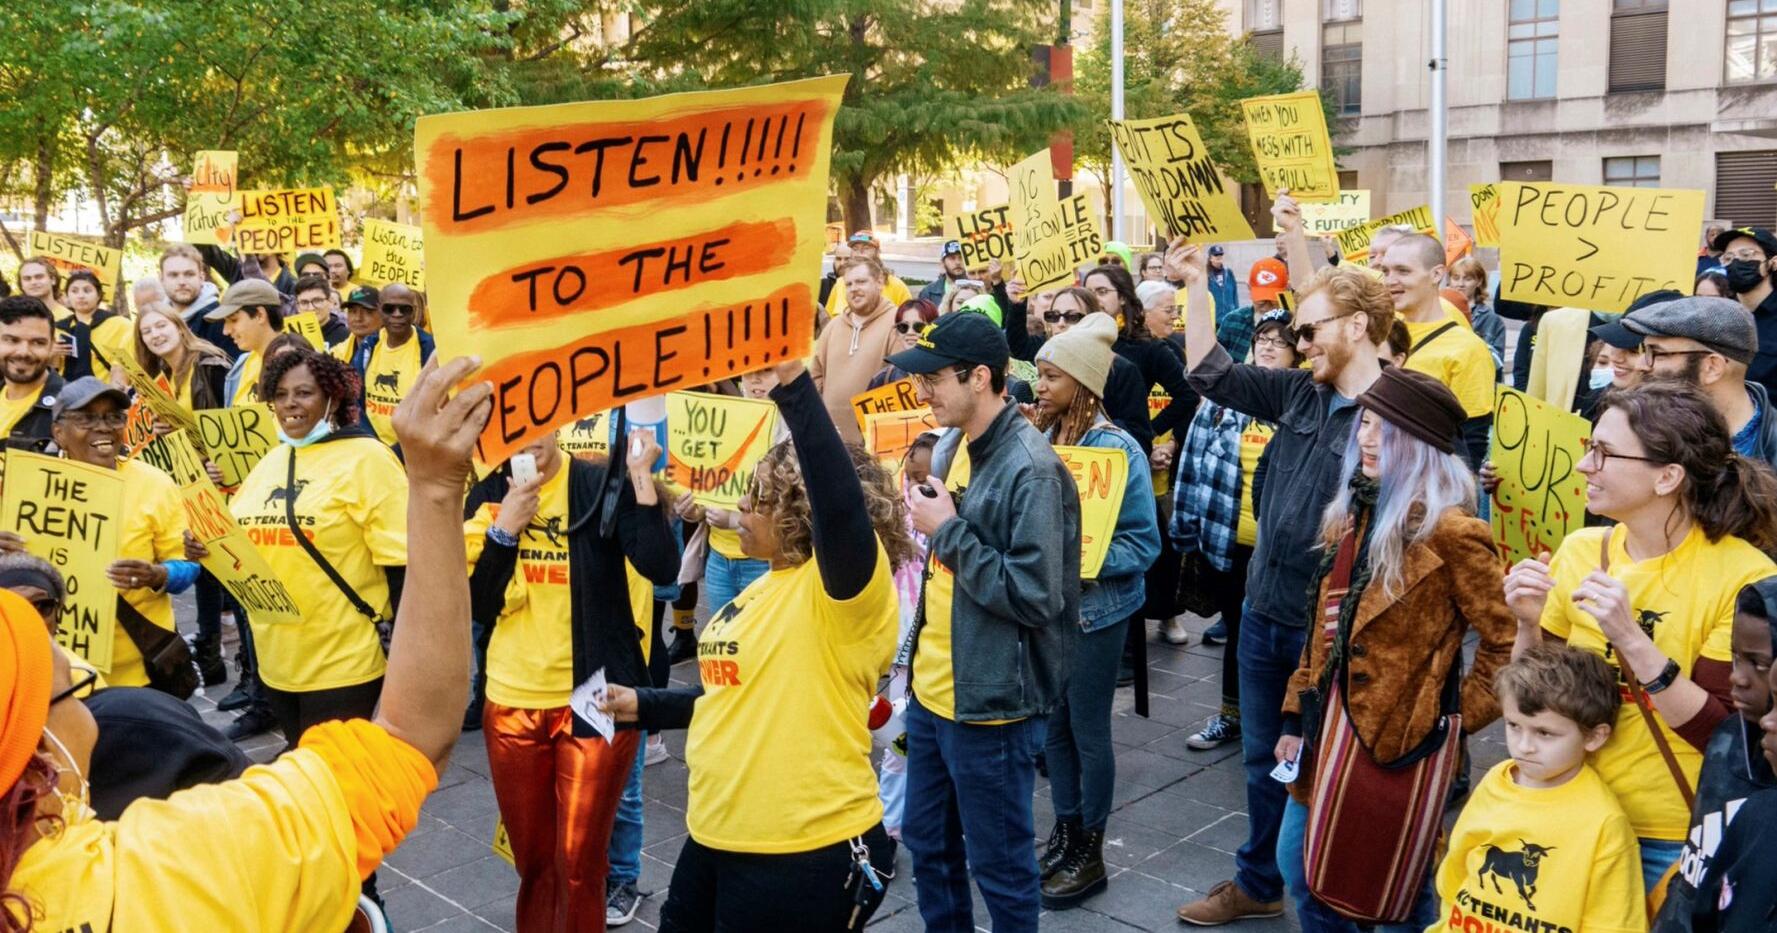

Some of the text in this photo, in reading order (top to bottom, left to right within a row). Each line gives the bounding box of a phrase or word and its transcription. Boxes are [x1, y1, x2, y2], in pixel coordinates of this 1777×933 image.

[1274, 104, 1298, 127] YOU
[1154, 120, 1194, 163] IS
[1281, 134, 1314, 156] WITH
[453, 111, 806, 222] LISTEN!!!!!
[1160, 154, 1225, 200] DAMN
[241, 191, 327, 217] LISTEN
[1513, 185, 1675, 232] PEOPLE
[34, 233, 109, 267] LISTEN
[1337, 225, 1370, 255] MESS
[371, 260, 420, 286] PEOPLE
[511, 238, 731, 311] TO THE
[200, 408, 270, 449] OUR
[566, 441, 607, 450] TENANTS
[681, 439, 723, 460] GET
[1496, 391, 1573, 536] OUR
[39, 468, 88, 503] THE
[690, 464, 747, 497] HORN
[16, 500, 110, 552] RENT
[254, 515, 316, 526] TENATS
[50, 547, 68, 566] IS
